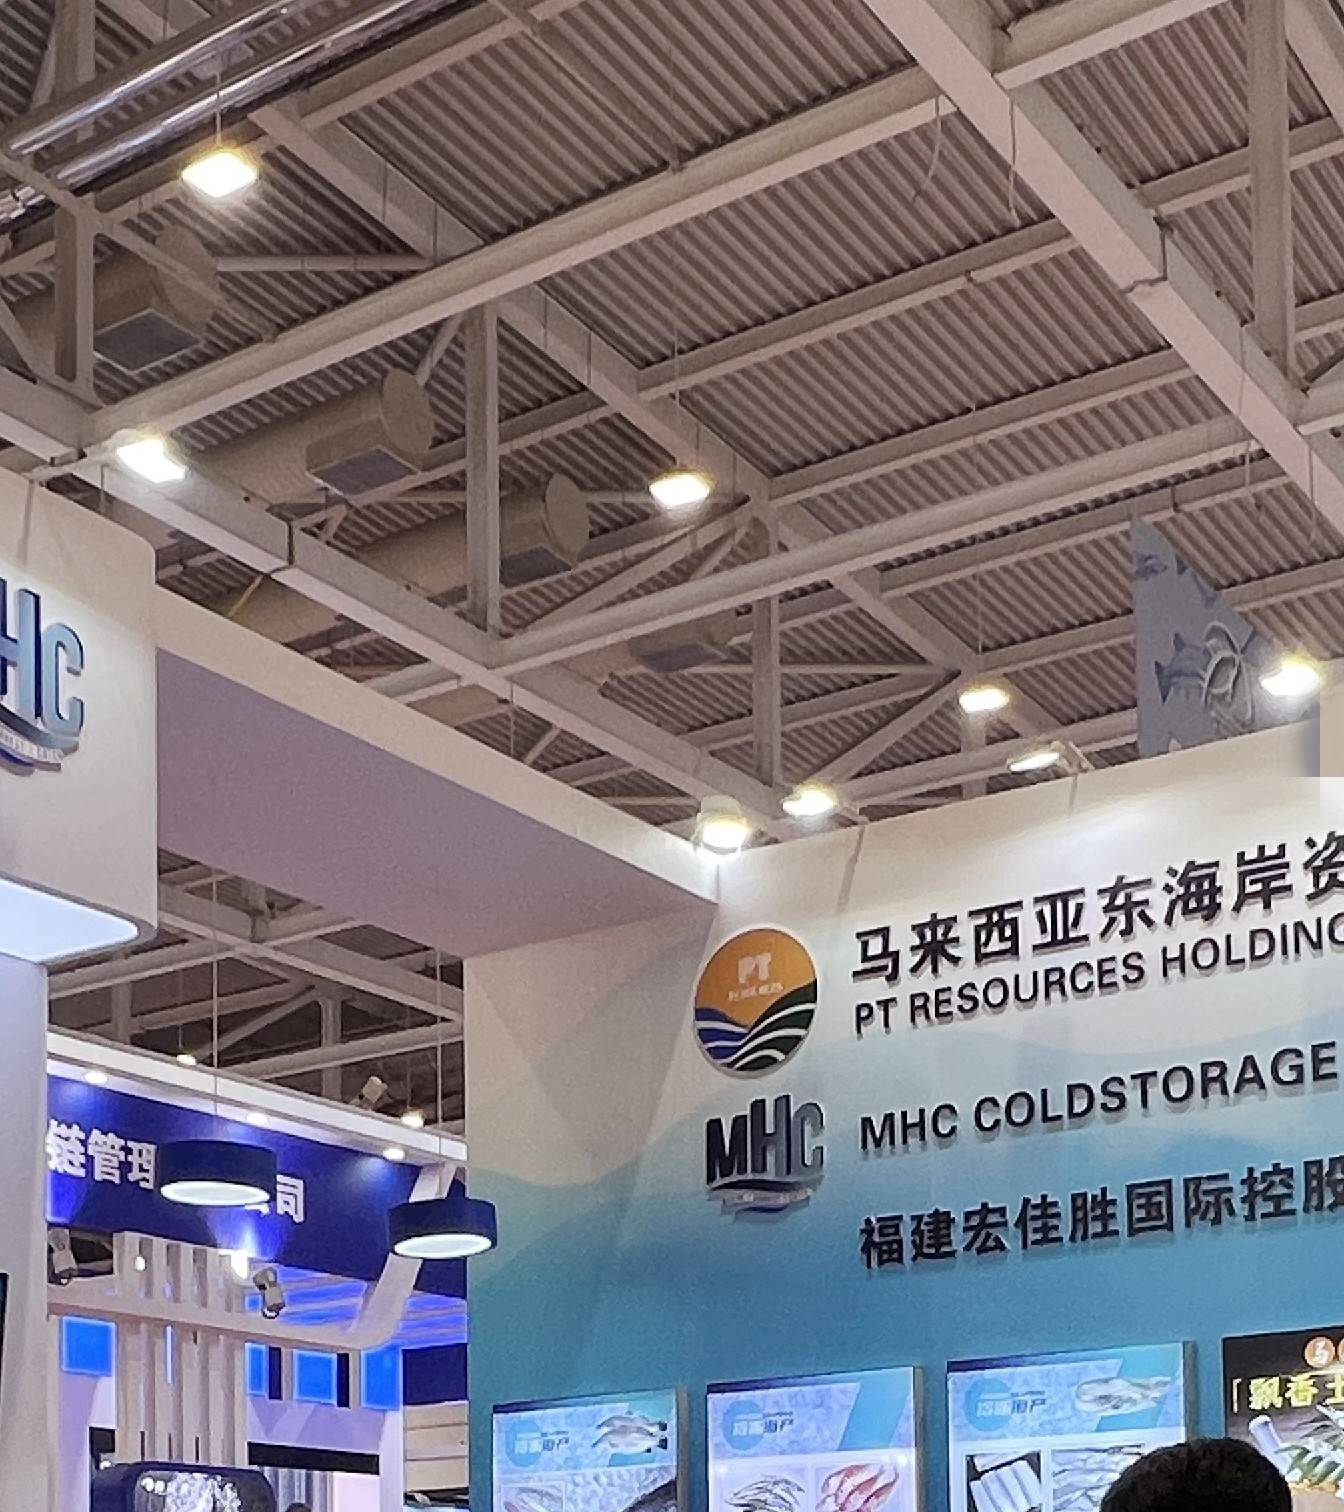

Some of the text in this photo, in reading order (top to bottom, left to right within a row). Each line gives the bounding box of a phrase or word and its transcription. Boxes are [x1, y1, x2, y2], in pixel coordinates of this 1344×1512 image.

[738, 952, 772, 984] PT
[855, 997, 897, 1037] PT
[910, 951, 1147, 1027] RESOURCES
[861, 1102, 958, 1151] MHC
[973, 1040, 1338, 1133] COLDSTORAGE
[706, 1094, 825, 1188] MHC
